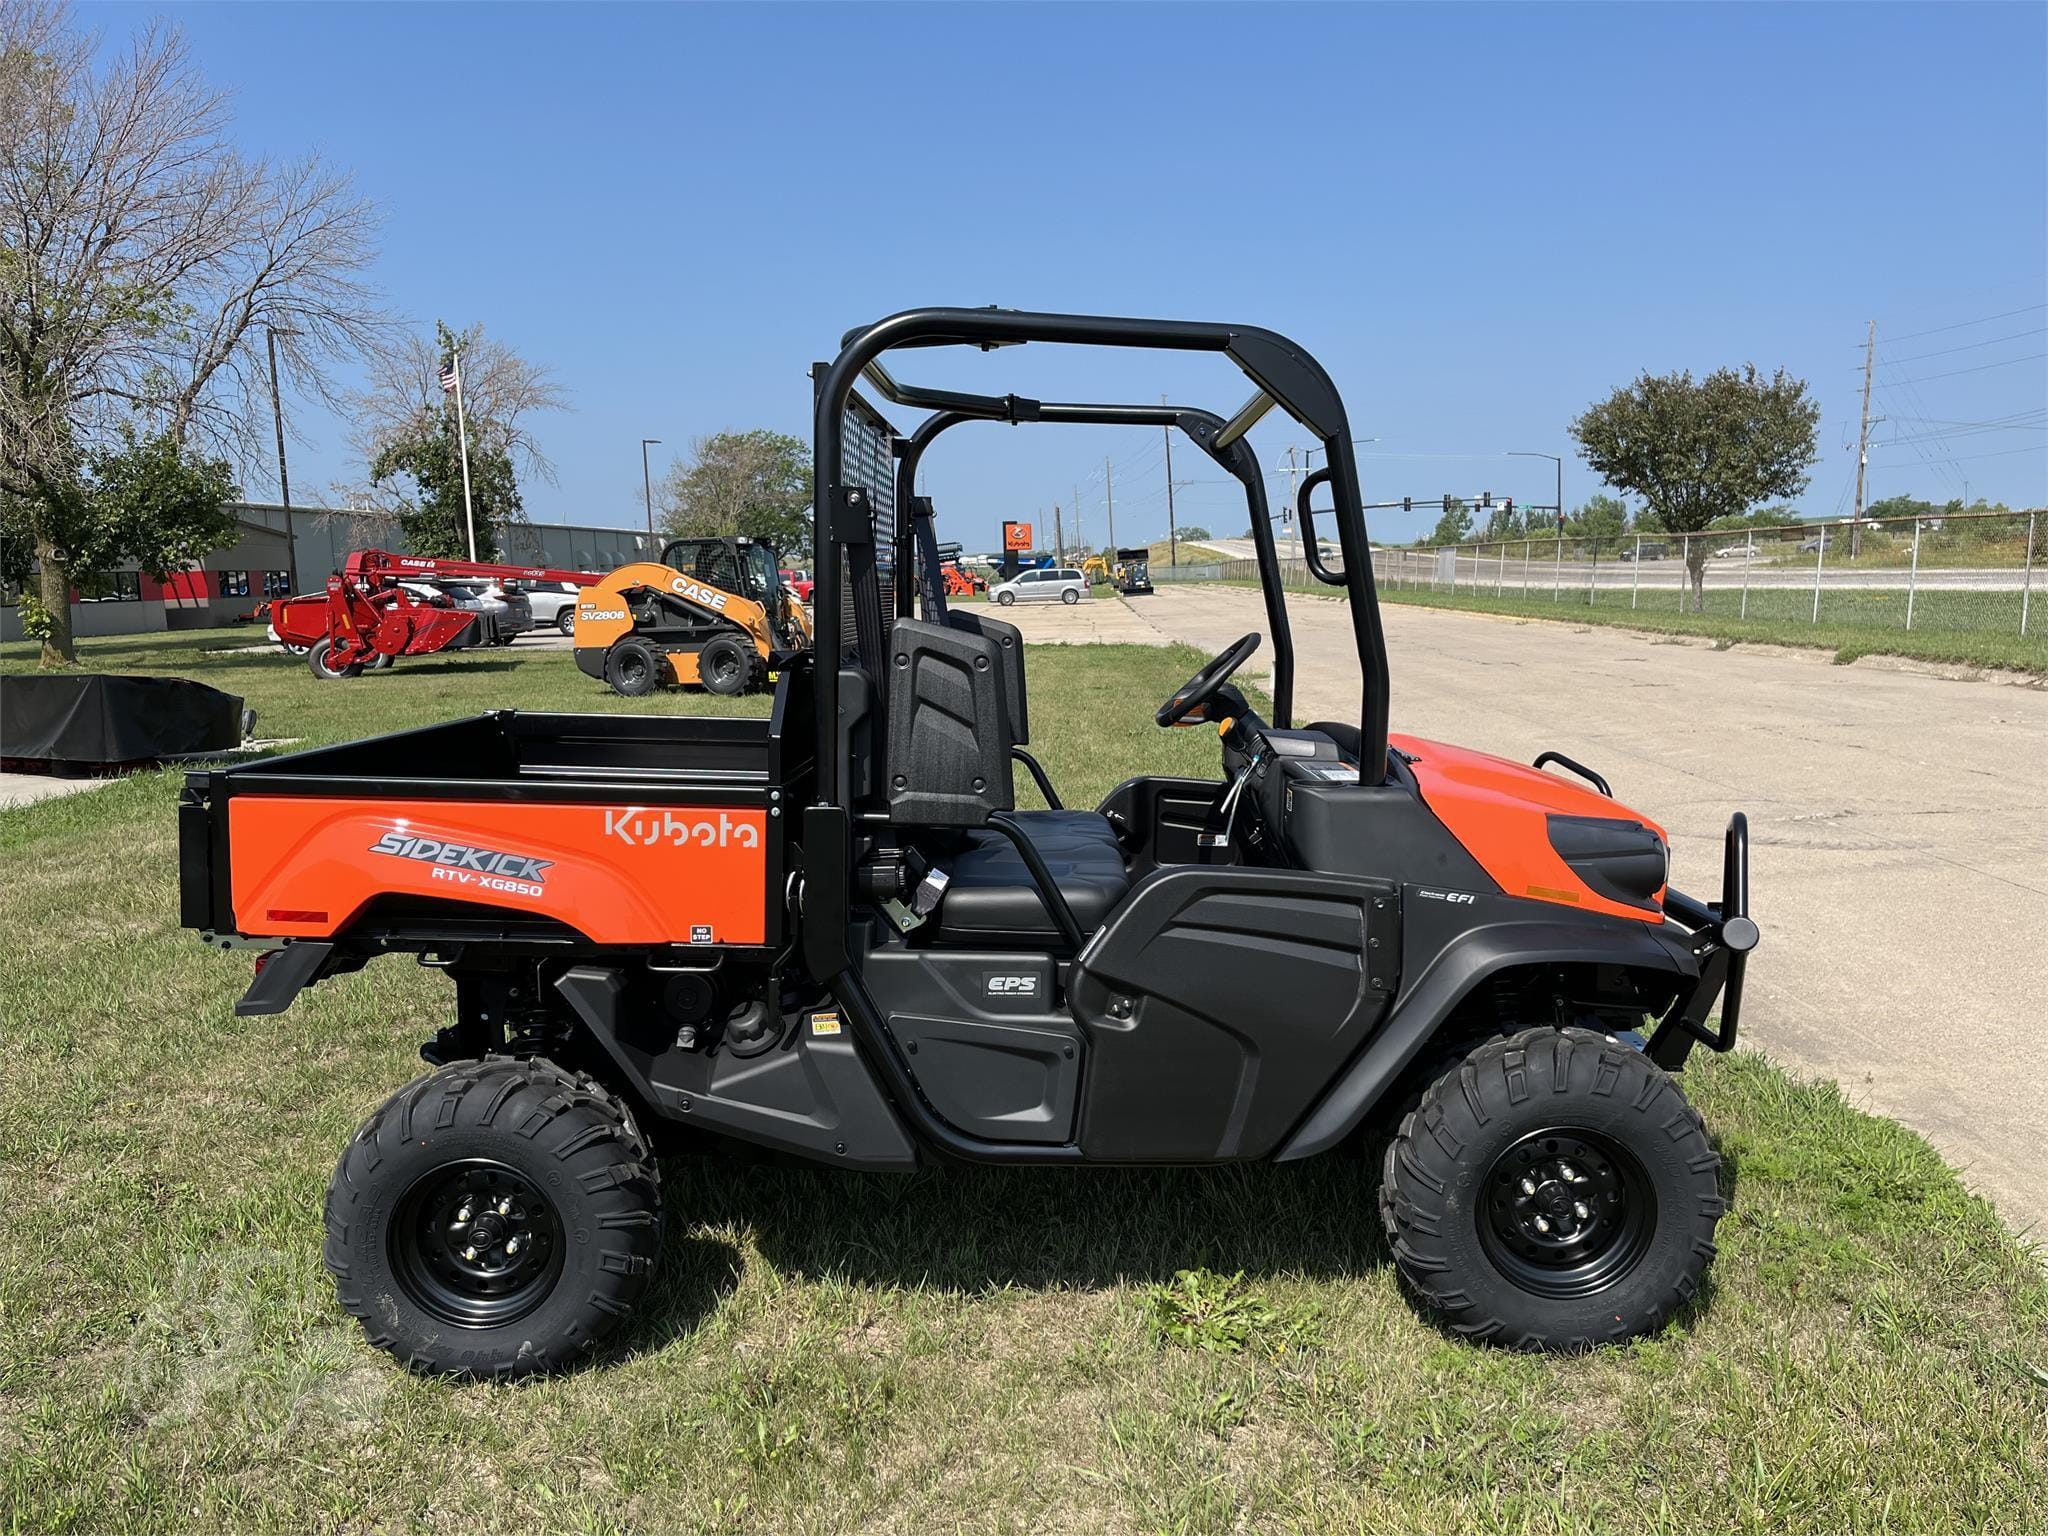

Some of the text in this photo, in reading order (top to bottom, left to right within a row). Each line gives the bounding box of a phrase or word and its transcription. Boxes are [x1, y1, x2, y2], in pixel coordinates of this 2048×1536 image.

[401, 559, 426, 568] CASE
[671, 577, 728, 609] CASE
[605, 810, 758, 848] Kubota
[369, 832, 555, 883] SIDEKICK
[431, 867, 543, 897] RTV-XG850
[1446, 892, 1475, 905] EFI
[988, 976, 1036, 991] EPS
